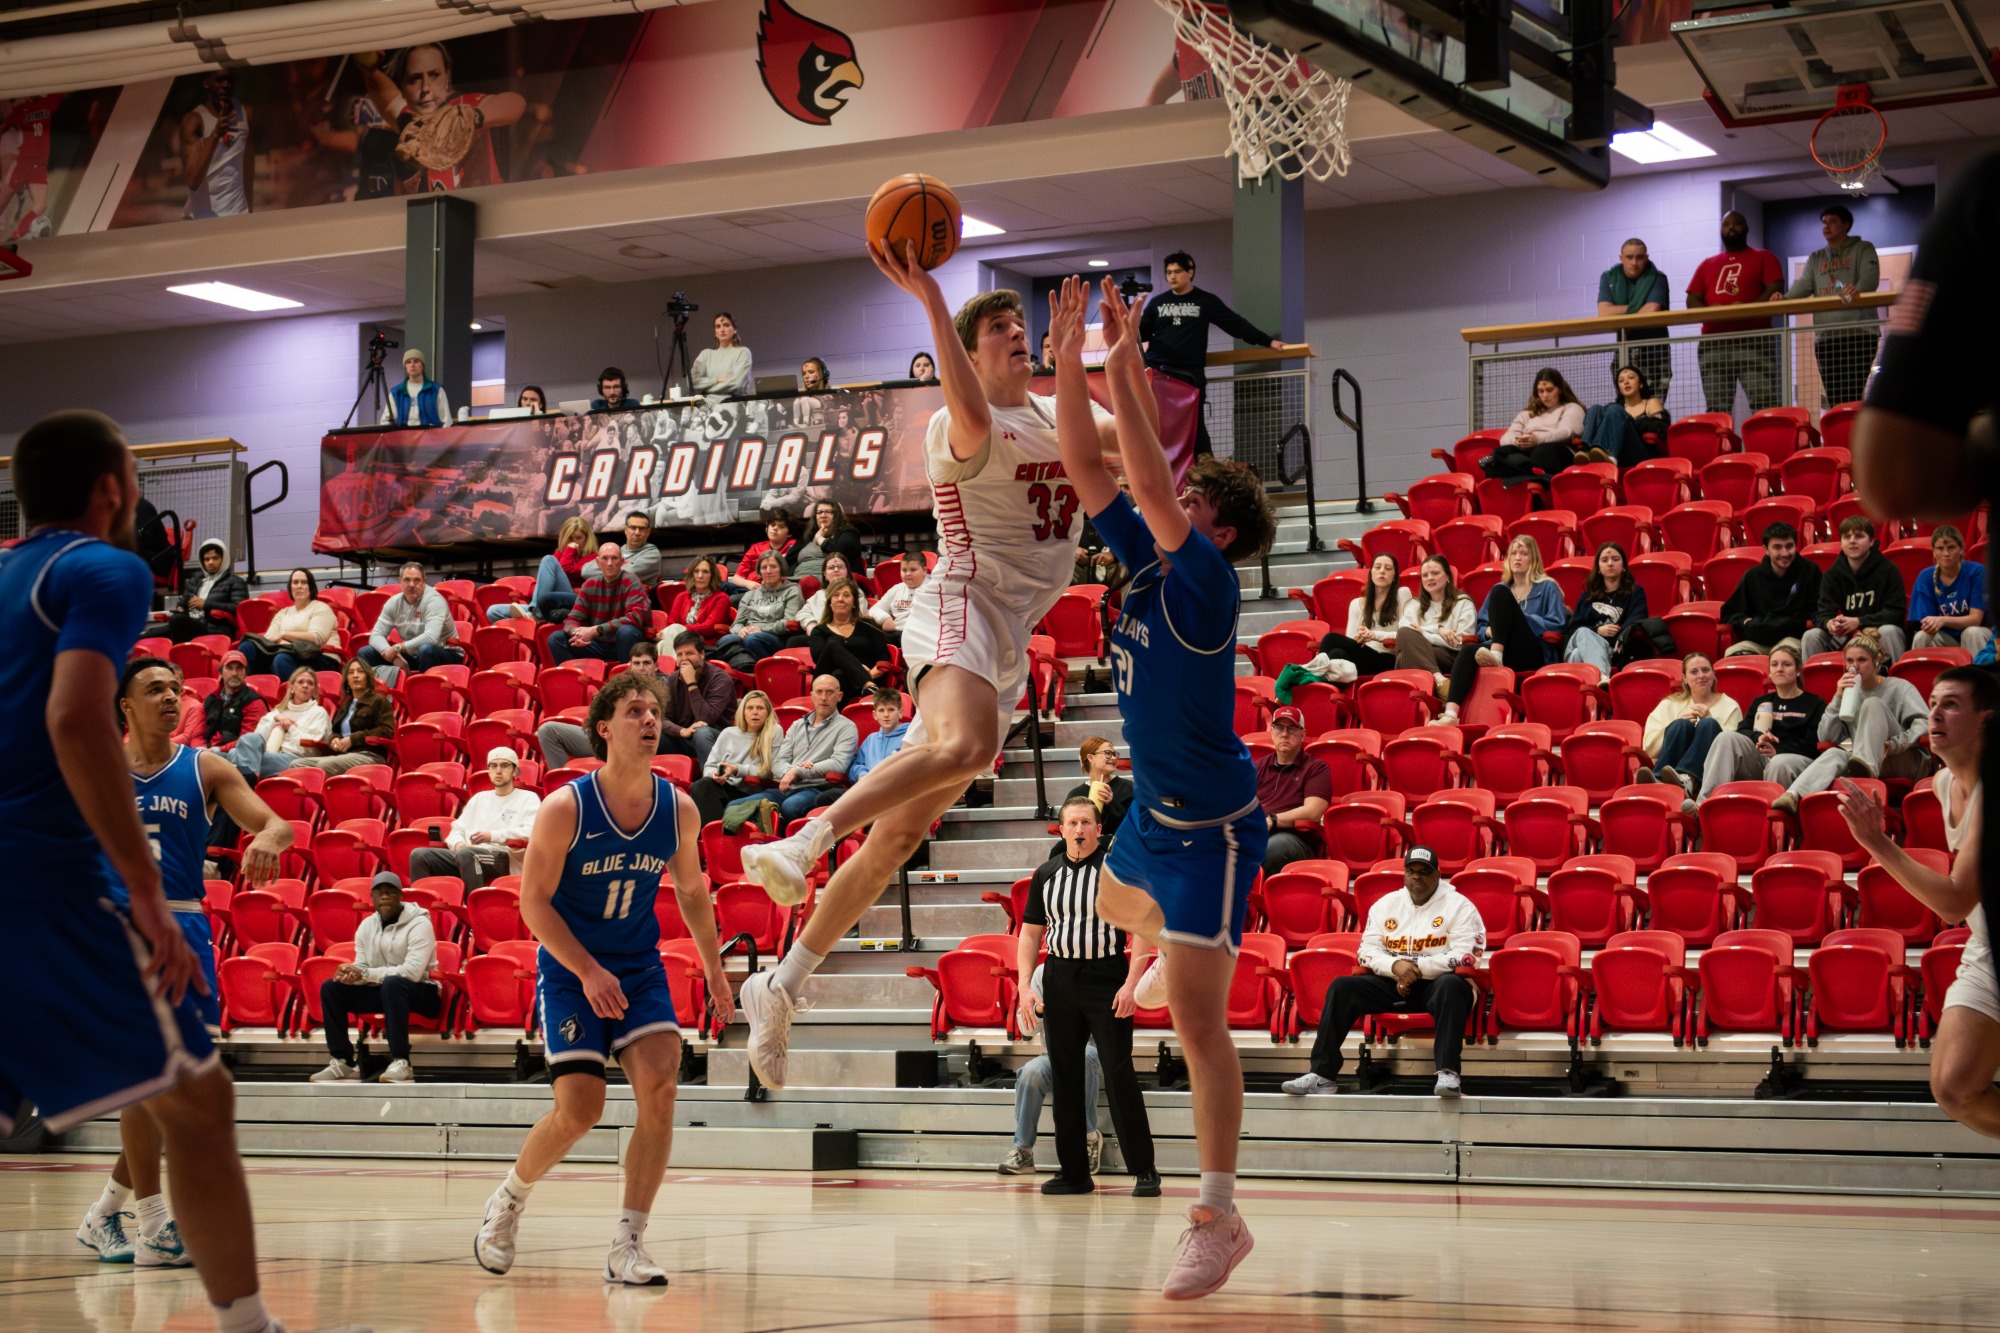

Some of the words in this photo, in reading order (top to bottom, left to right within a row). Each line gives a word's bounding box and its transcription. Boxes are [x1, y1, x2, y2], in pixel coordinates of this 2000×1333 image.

[1157, 305, 1201, 318] YANKEES
[544, 426, 888, 503] CARDINALS
[1027, 482, 1081, 541] 33
[1845, 590, 1875, 611] 1977
[1118, 613, 1150, 649] JAYS
[1111, 642, 1134, 696] 21
[149, 795, 188, 819] JAYS
[581, 853, 626, 876] BLUE
[628, 853, 666, 874] JAYS
[603, 880, 636, 920] 11
